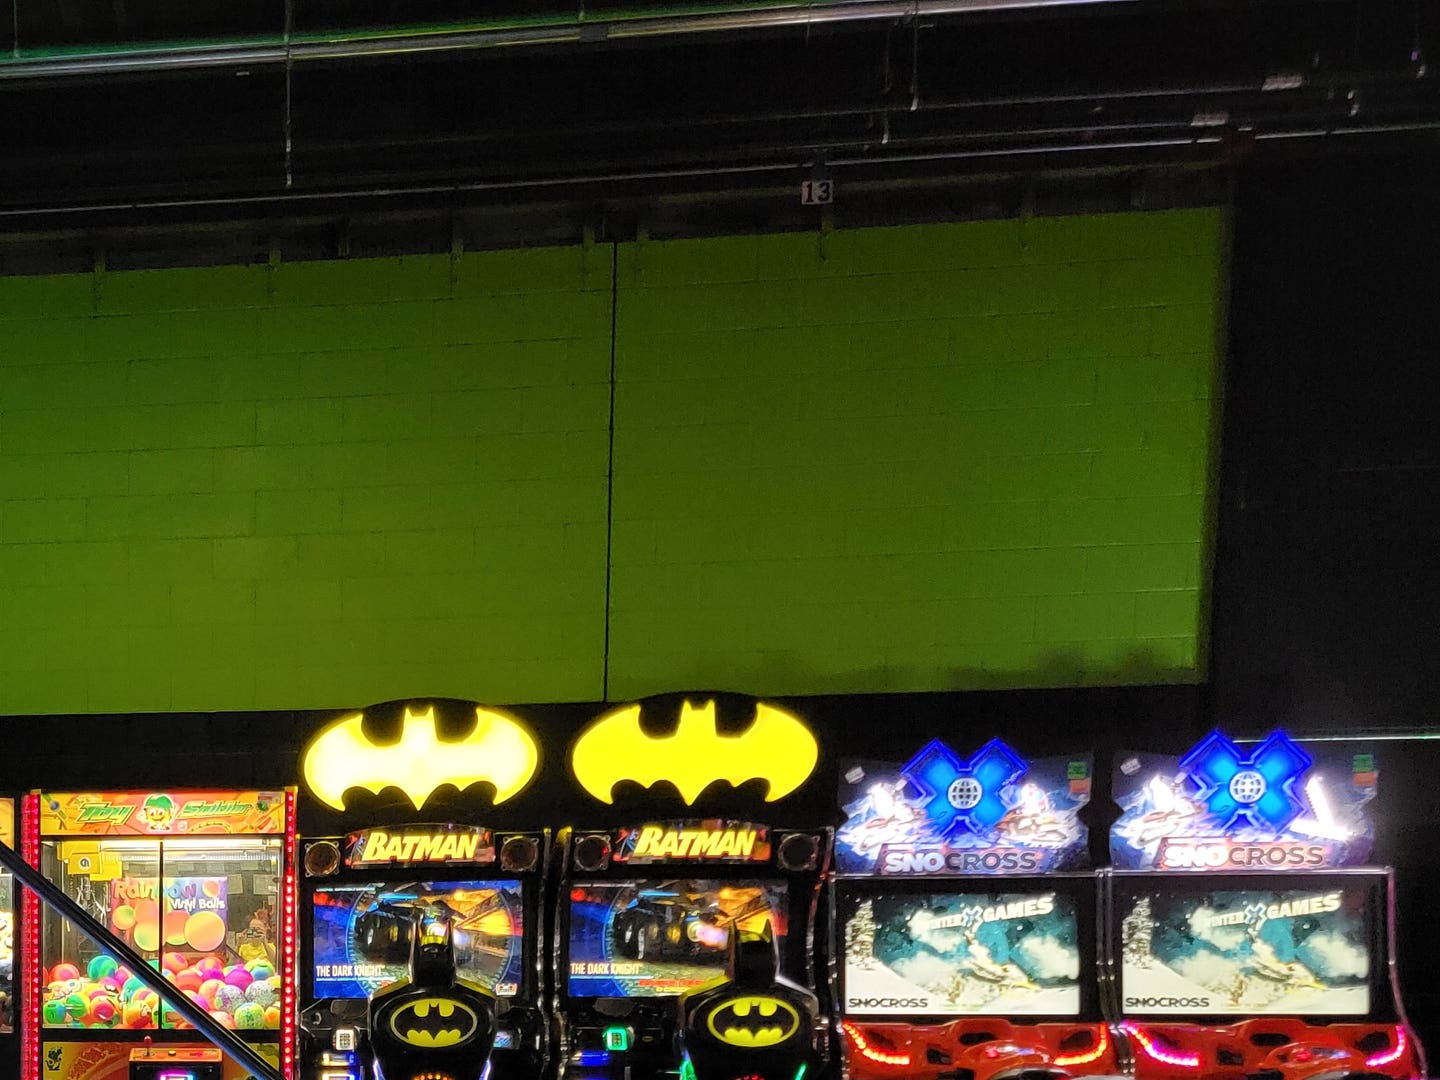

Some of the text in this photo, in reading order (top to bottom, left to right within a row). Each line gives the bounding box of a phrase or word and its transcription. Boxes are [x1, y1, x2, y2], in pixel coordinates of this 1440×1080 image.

[806, 182, 830, 202] 13
[78, 803, 136, 825] Toy
[362, 832, 478, 861] BATMAN
[633, 827, 756, 856] BATMAN
[884, 851, 1037, 873] SNOCROSS
[1164, 846, 1325, 868] SNOCROSS
[170, 898, 227, 913] Vinyl Balls
[983, 896, 1054, 922] GAMES
[1266, 893, 1342, 919] GAMES
[316, 965, 382, 977] THE DARK KNIGHT
[570, 963, 641, 975] THE DARK KNIGHT
[848, 998, 929, 1009] SNOCROSS
[1125, 997, 1211, 1008] SNOCROSS
